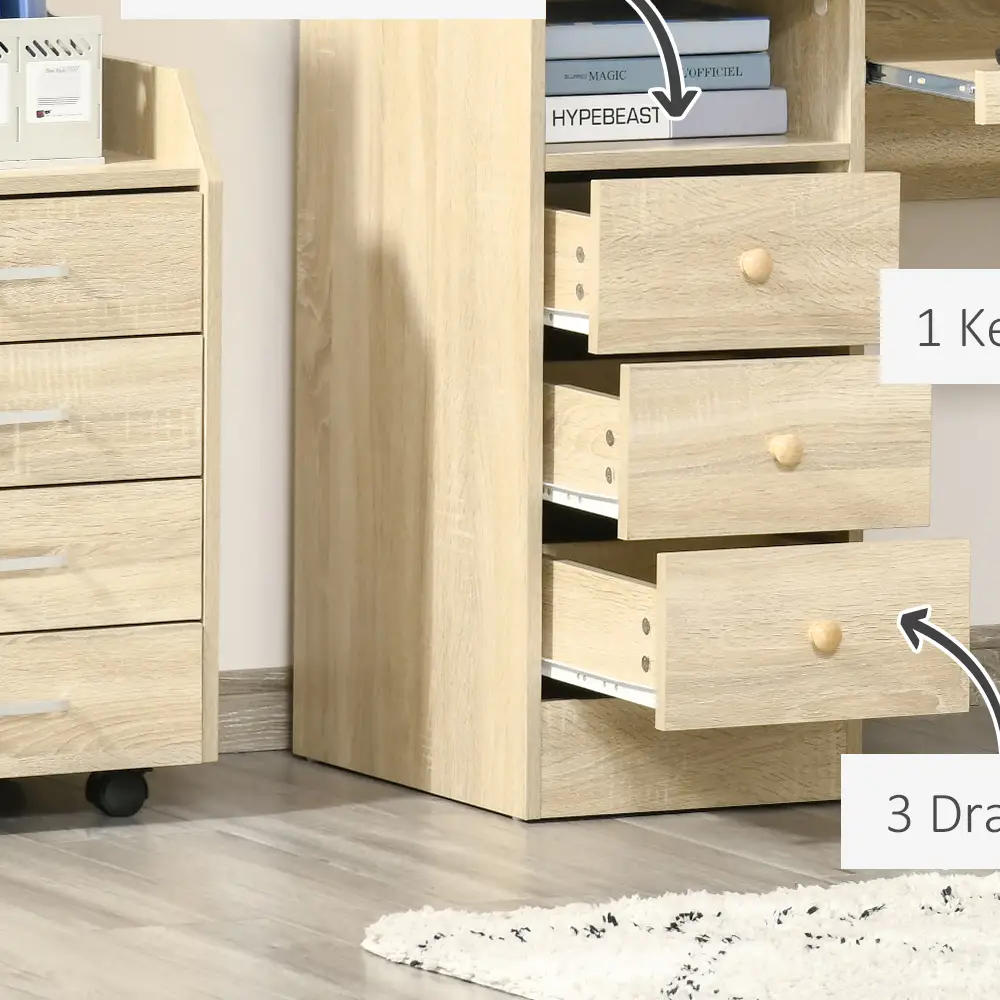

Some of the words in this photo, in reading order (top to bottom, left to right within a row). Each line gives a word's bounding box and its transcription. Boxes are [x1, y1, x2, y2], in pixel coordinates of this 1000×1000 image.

[588, 70, 627, 81] MAGIC
[683, 66, 743, 79] 'OFFICIEL
[552, 106, 660, 127] HYPEBEAST
